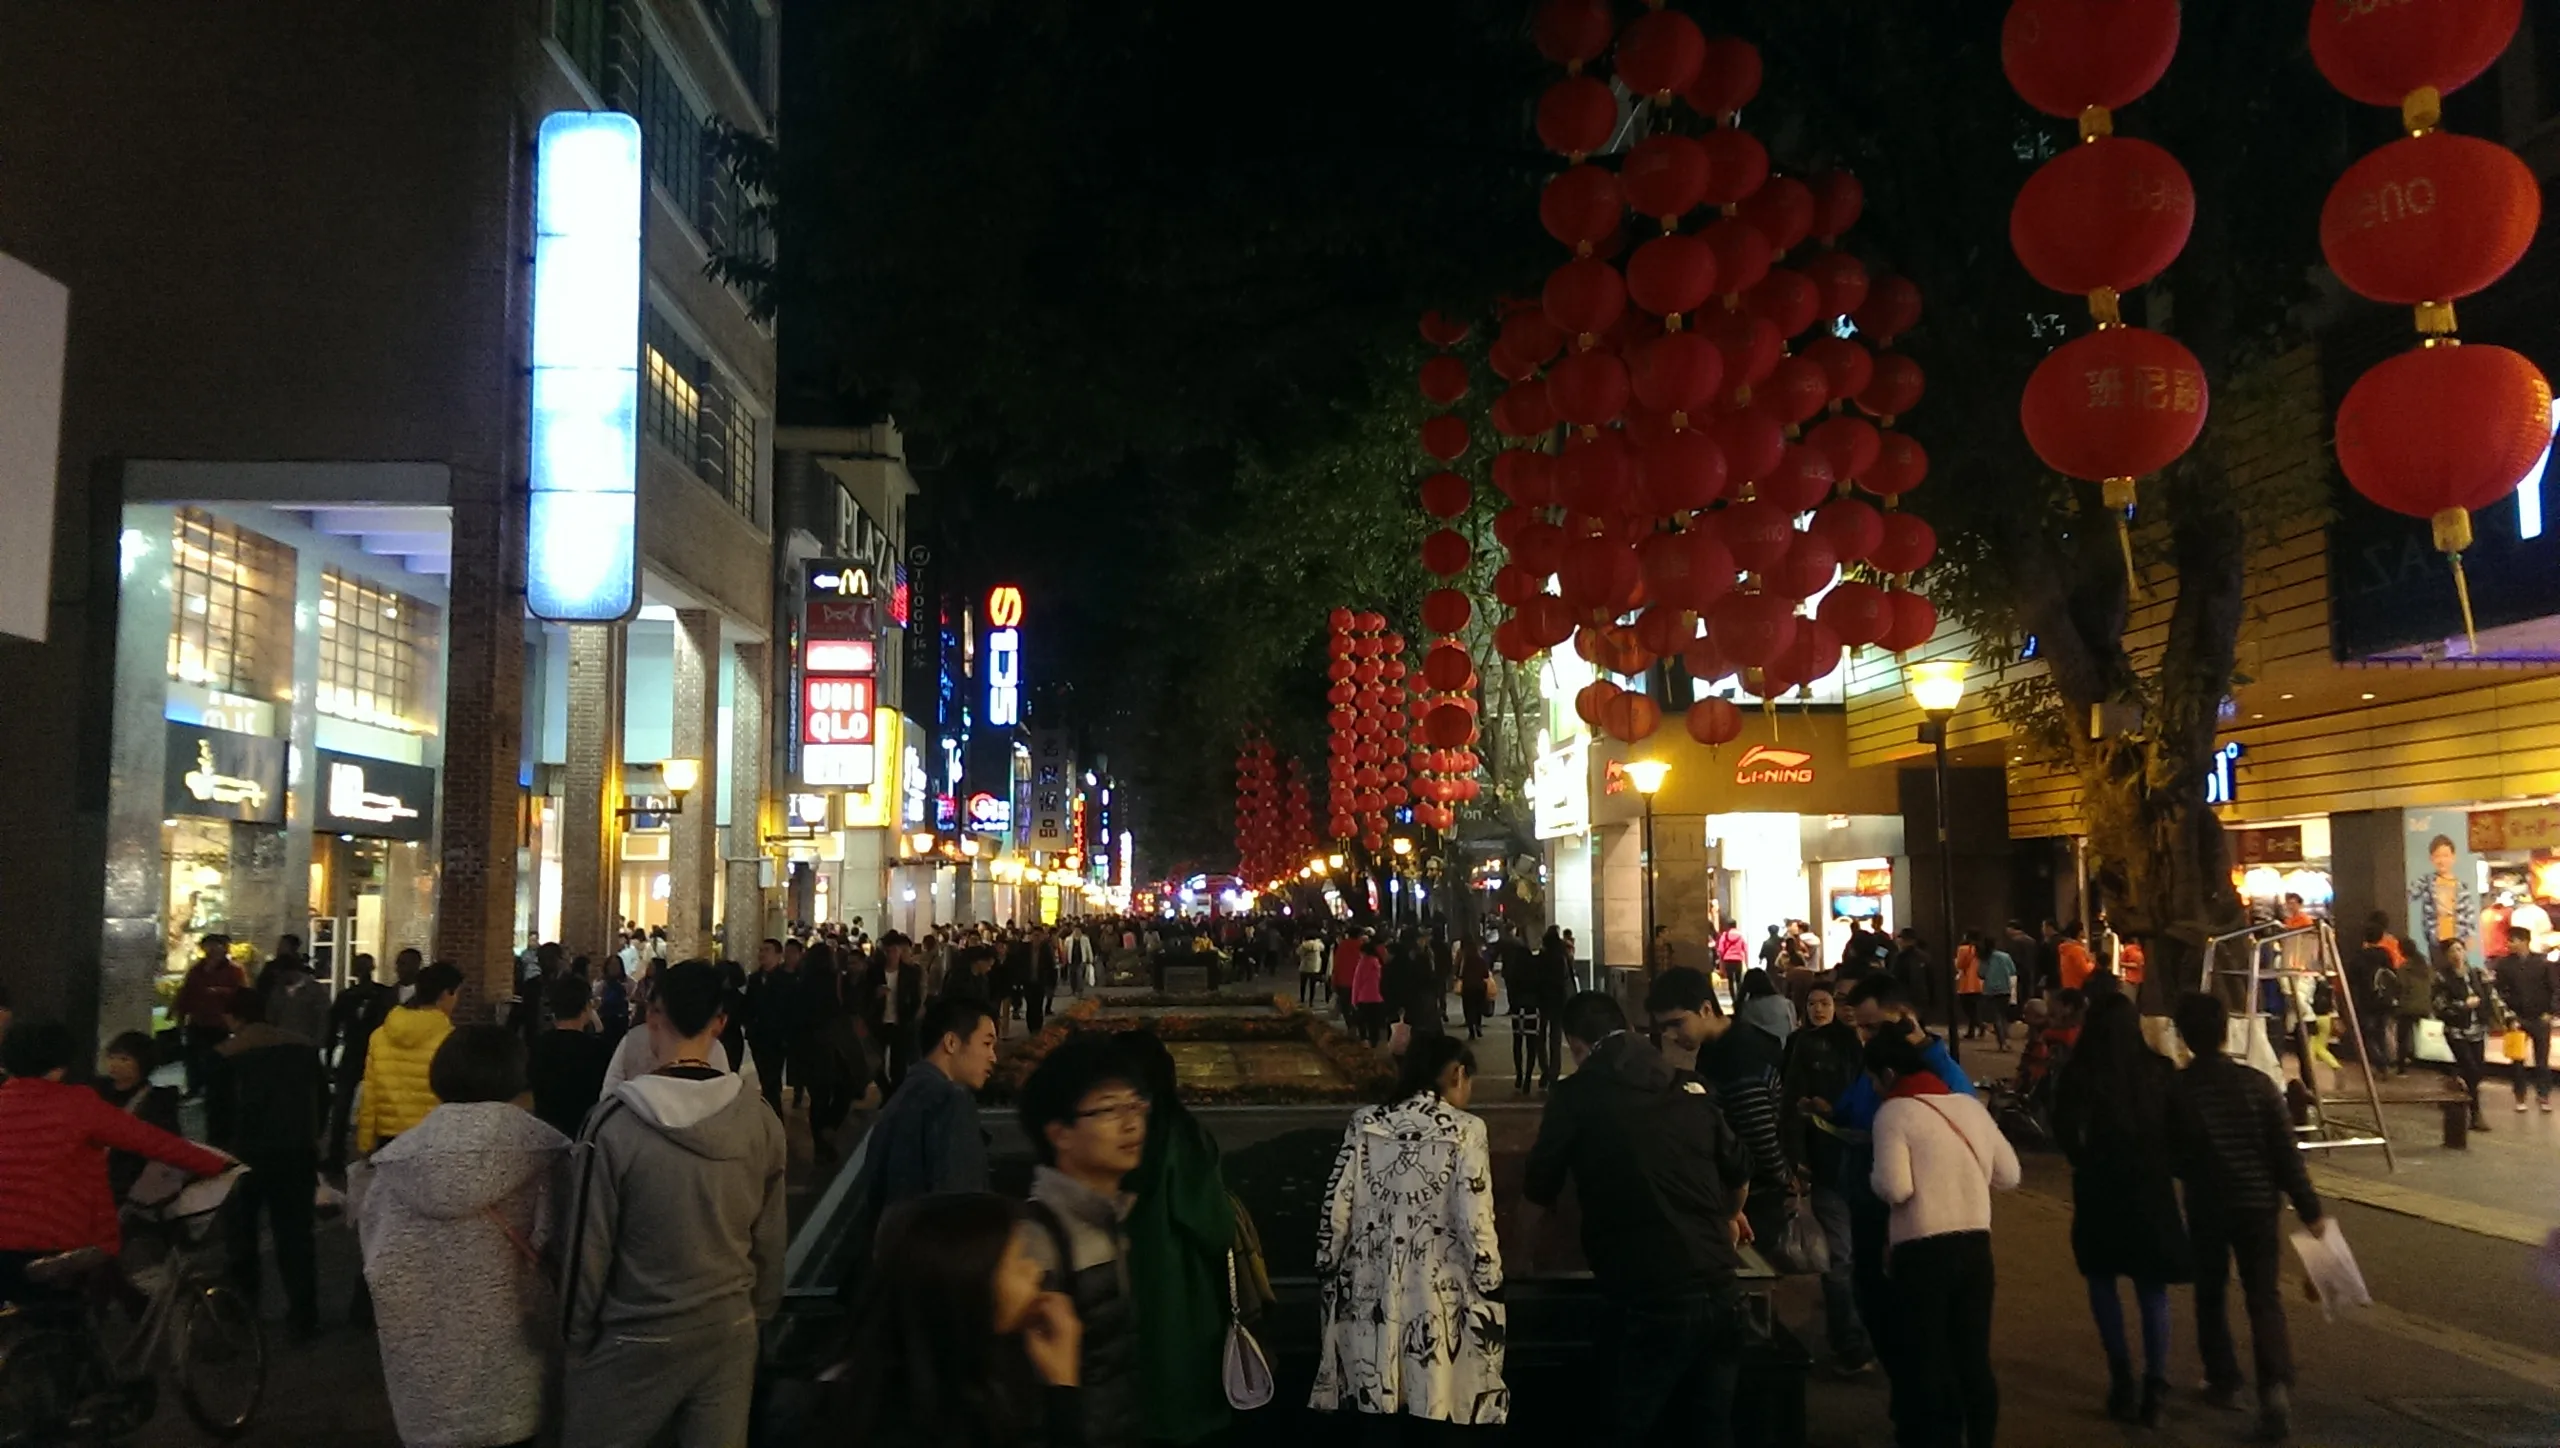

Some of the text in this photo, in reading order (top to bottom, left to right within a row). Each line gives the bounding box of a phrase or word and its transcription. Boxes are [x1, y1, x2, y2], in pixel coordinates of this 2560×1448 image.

[836, 484, 898, 598] PLAZA
[810, 682, 865, 711] UNI
[810, 711, 869, 742] QLO
[1362, 1101, 1458, 1137] ONE PIECE
